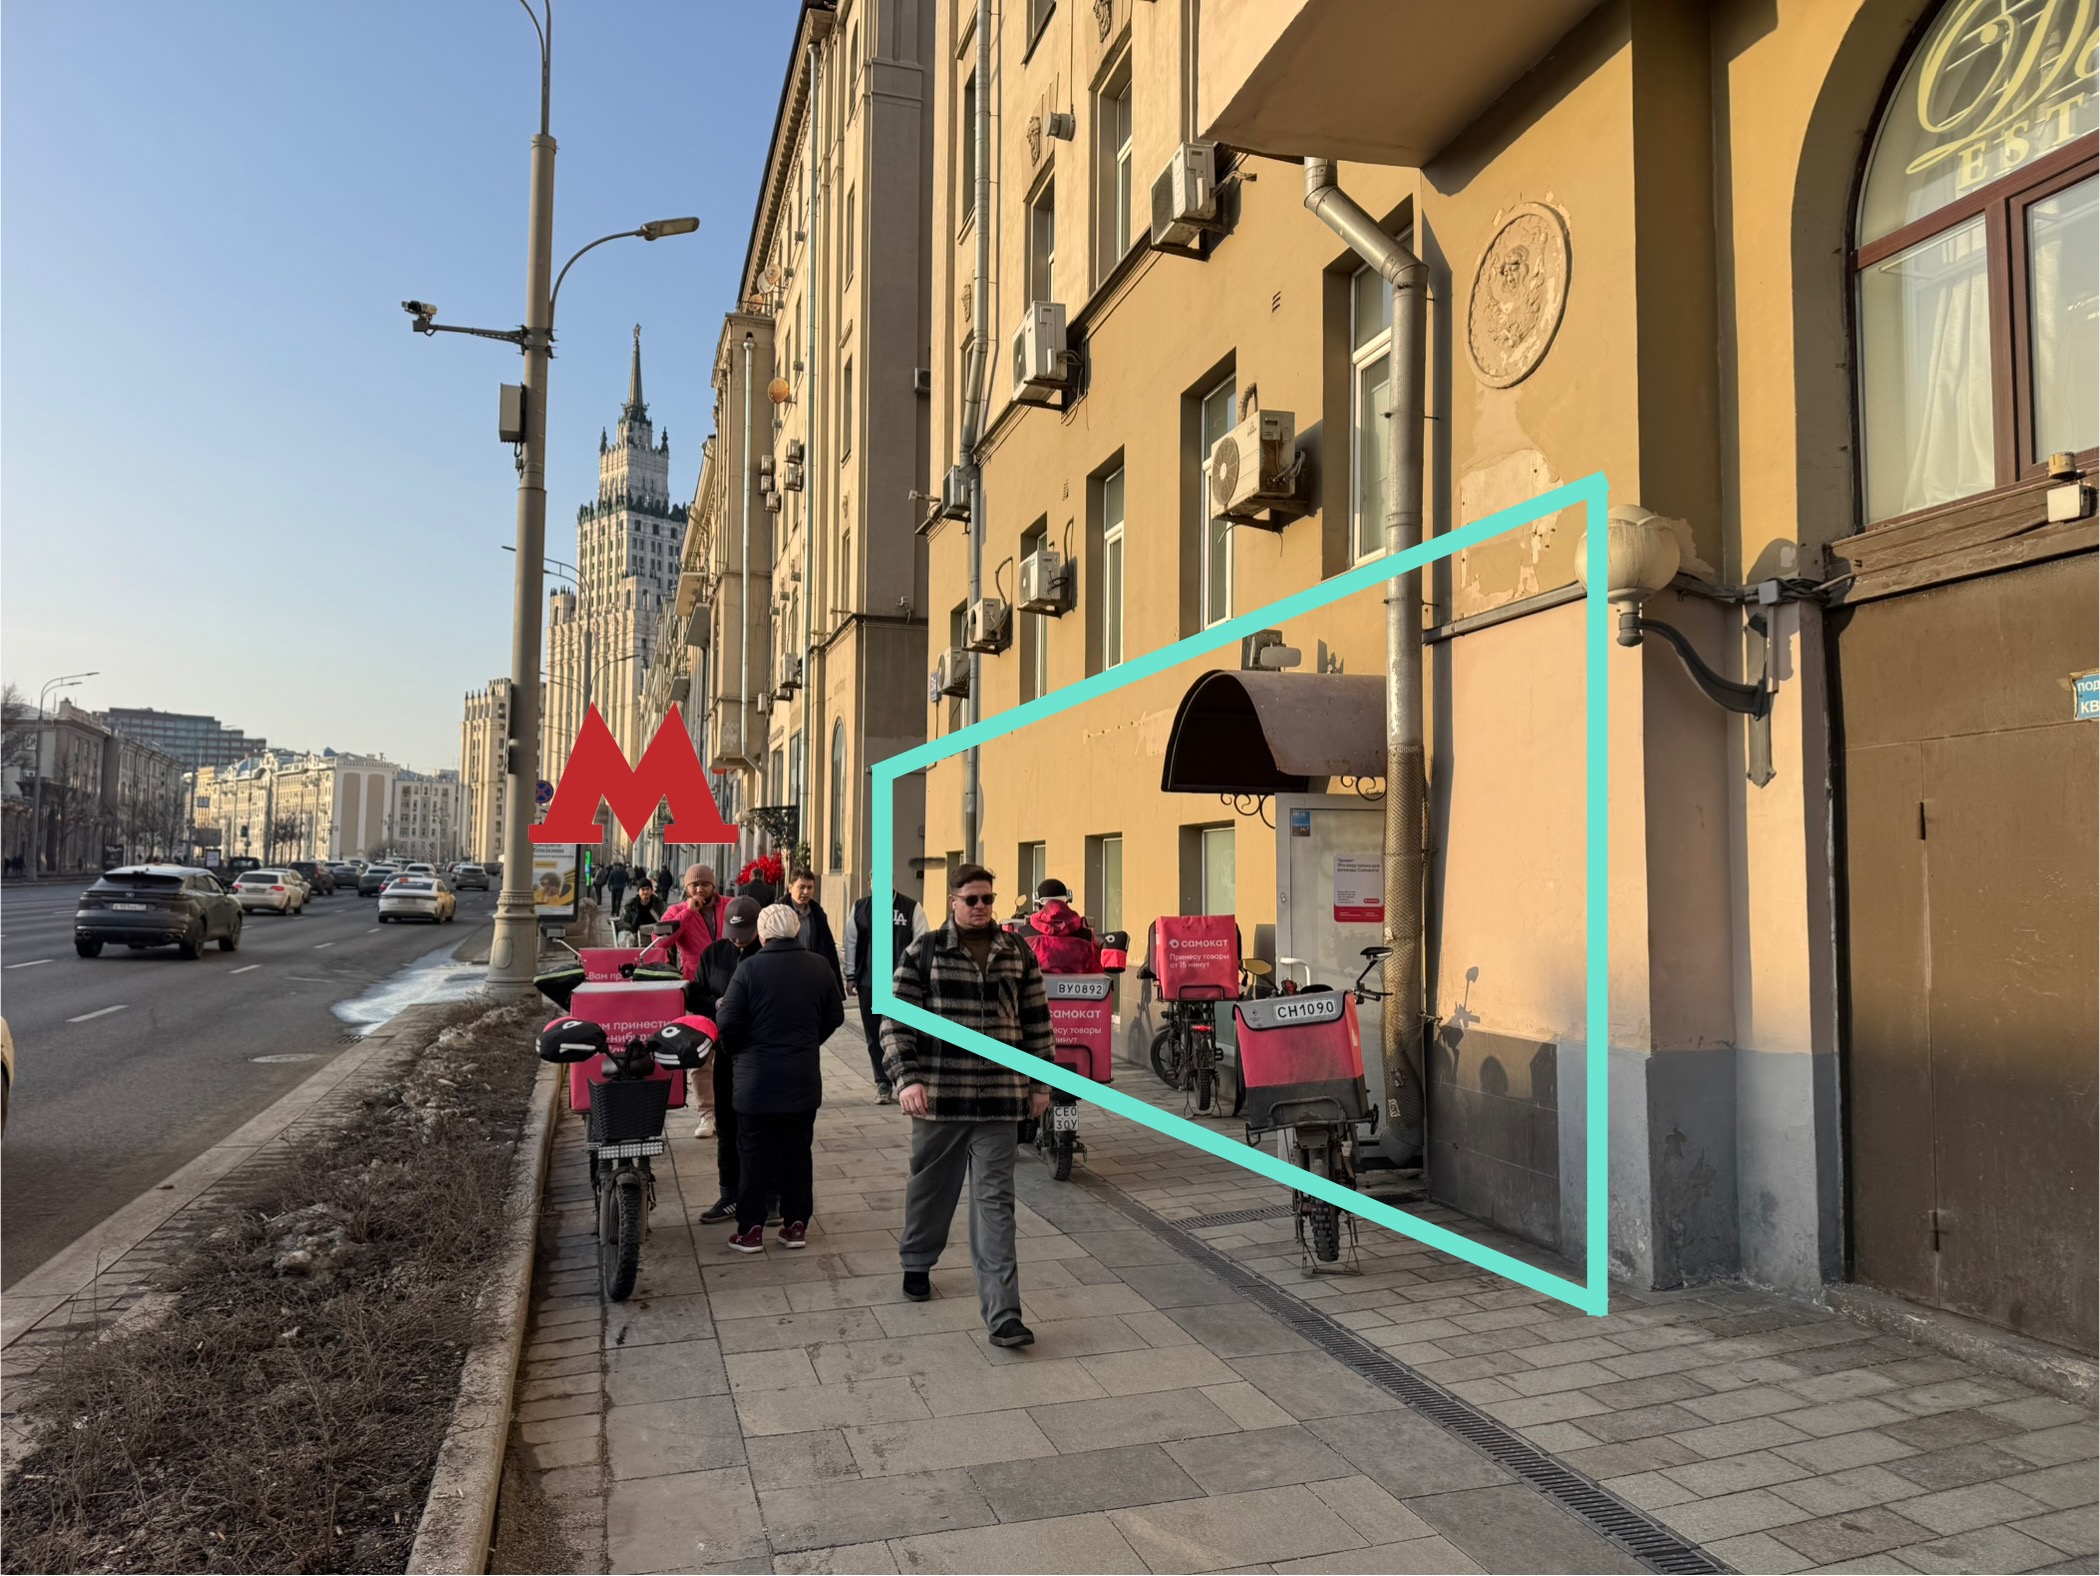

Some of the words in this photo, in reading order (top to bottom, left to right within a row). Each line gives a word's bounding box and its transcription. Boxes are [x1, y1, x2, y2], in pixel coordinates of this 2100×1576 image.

[1955, 92, 2085, 191] EST
[1181, 939, 1229, 948] самокат
[1169, 953, 1202, 963] Принесу
[1203, 953, 1230, 963] товары
[588, 971, 608, 980] Вам
